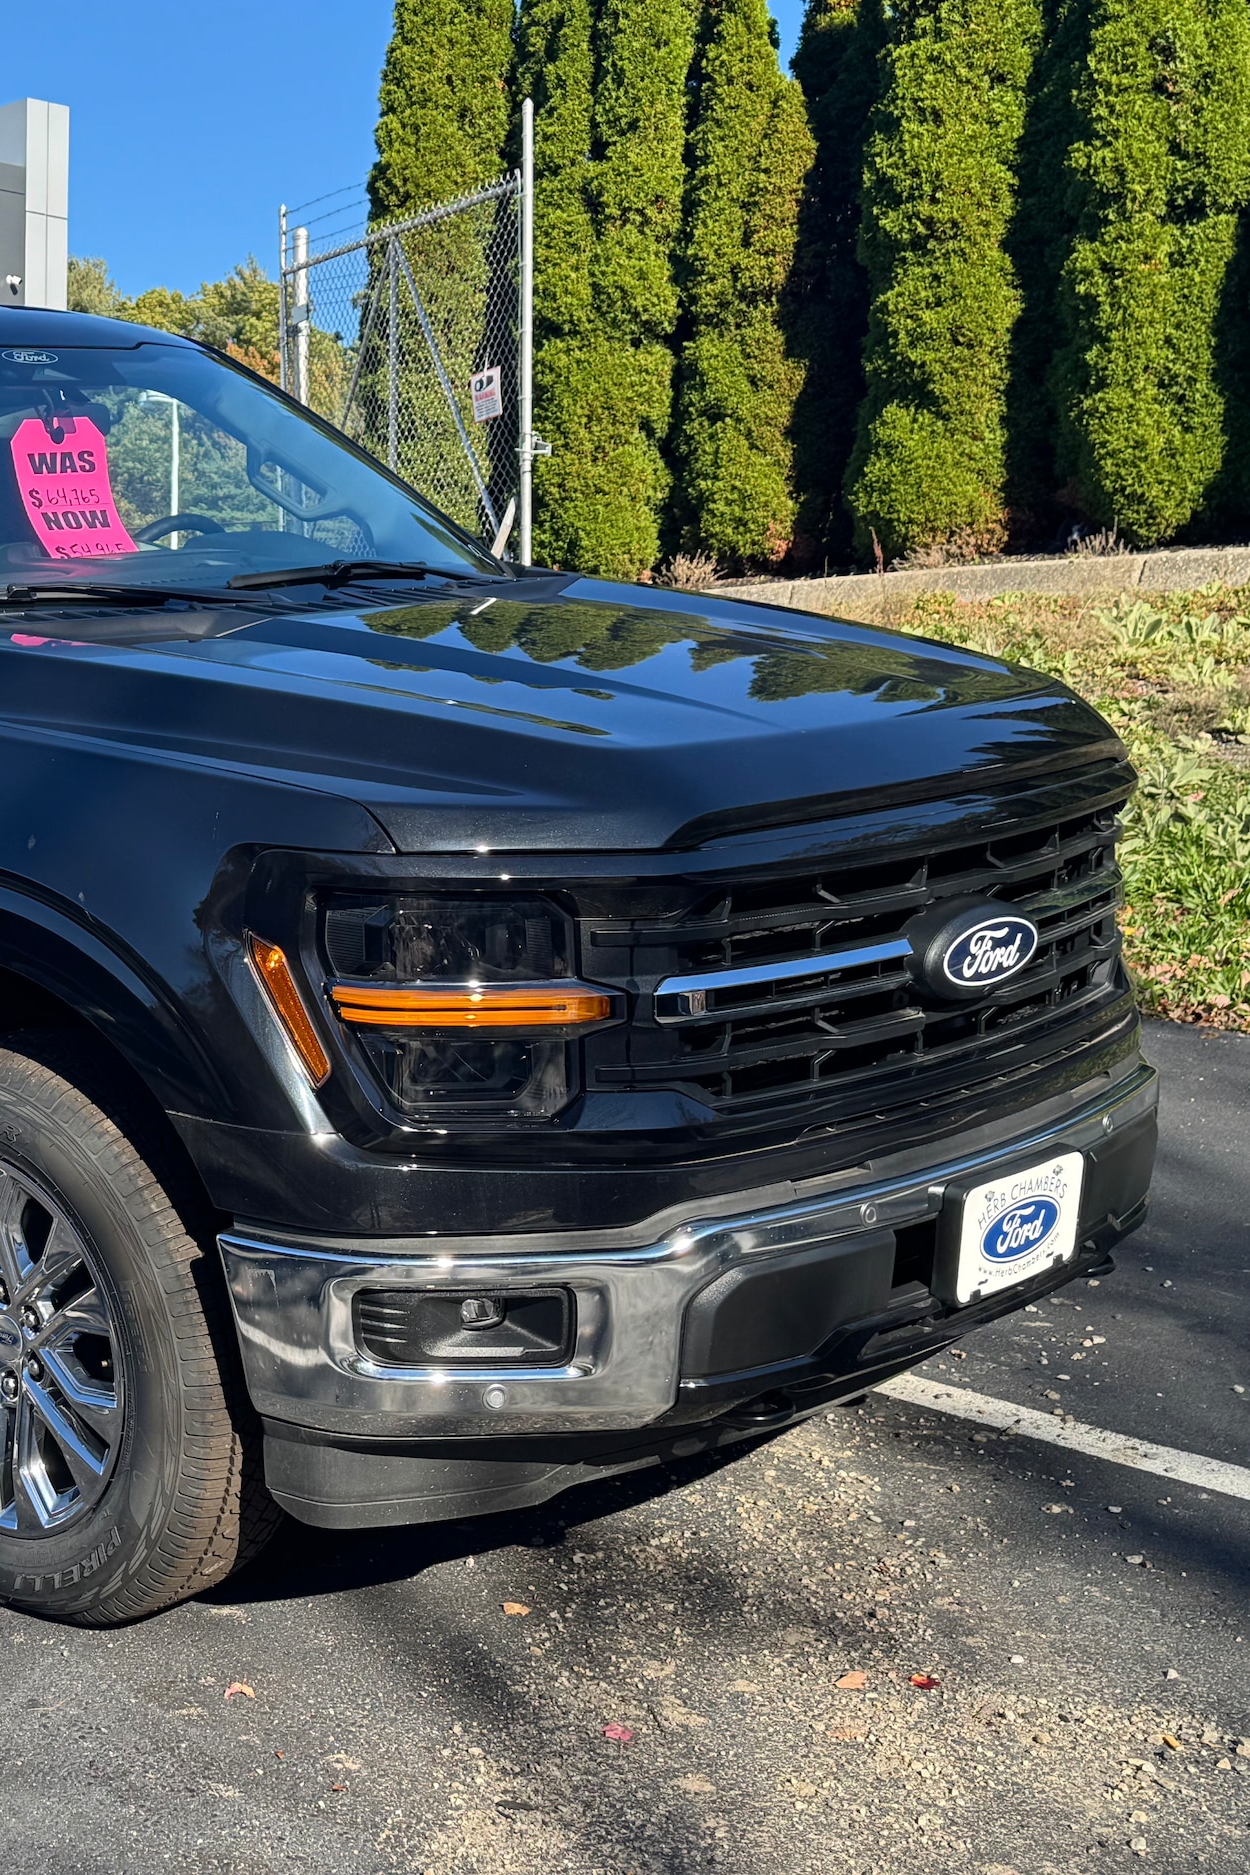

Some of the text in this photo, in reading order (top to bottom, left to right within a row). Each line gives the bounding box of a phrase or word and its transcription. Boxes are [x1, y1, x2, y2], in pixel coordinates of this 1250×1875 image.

[12, 351, 50, 362] Ford
[27, 450, 96, 474] WAS
[41, 510, 111, 531] NOW
[962, 926, 1023, 978] Ford
[978, 1175, 1068, 1230] HERB CHAMBERS
[996, 1204, 1046, 1254] Ford
[12, 1526, 122, 1592] PIRELLI
